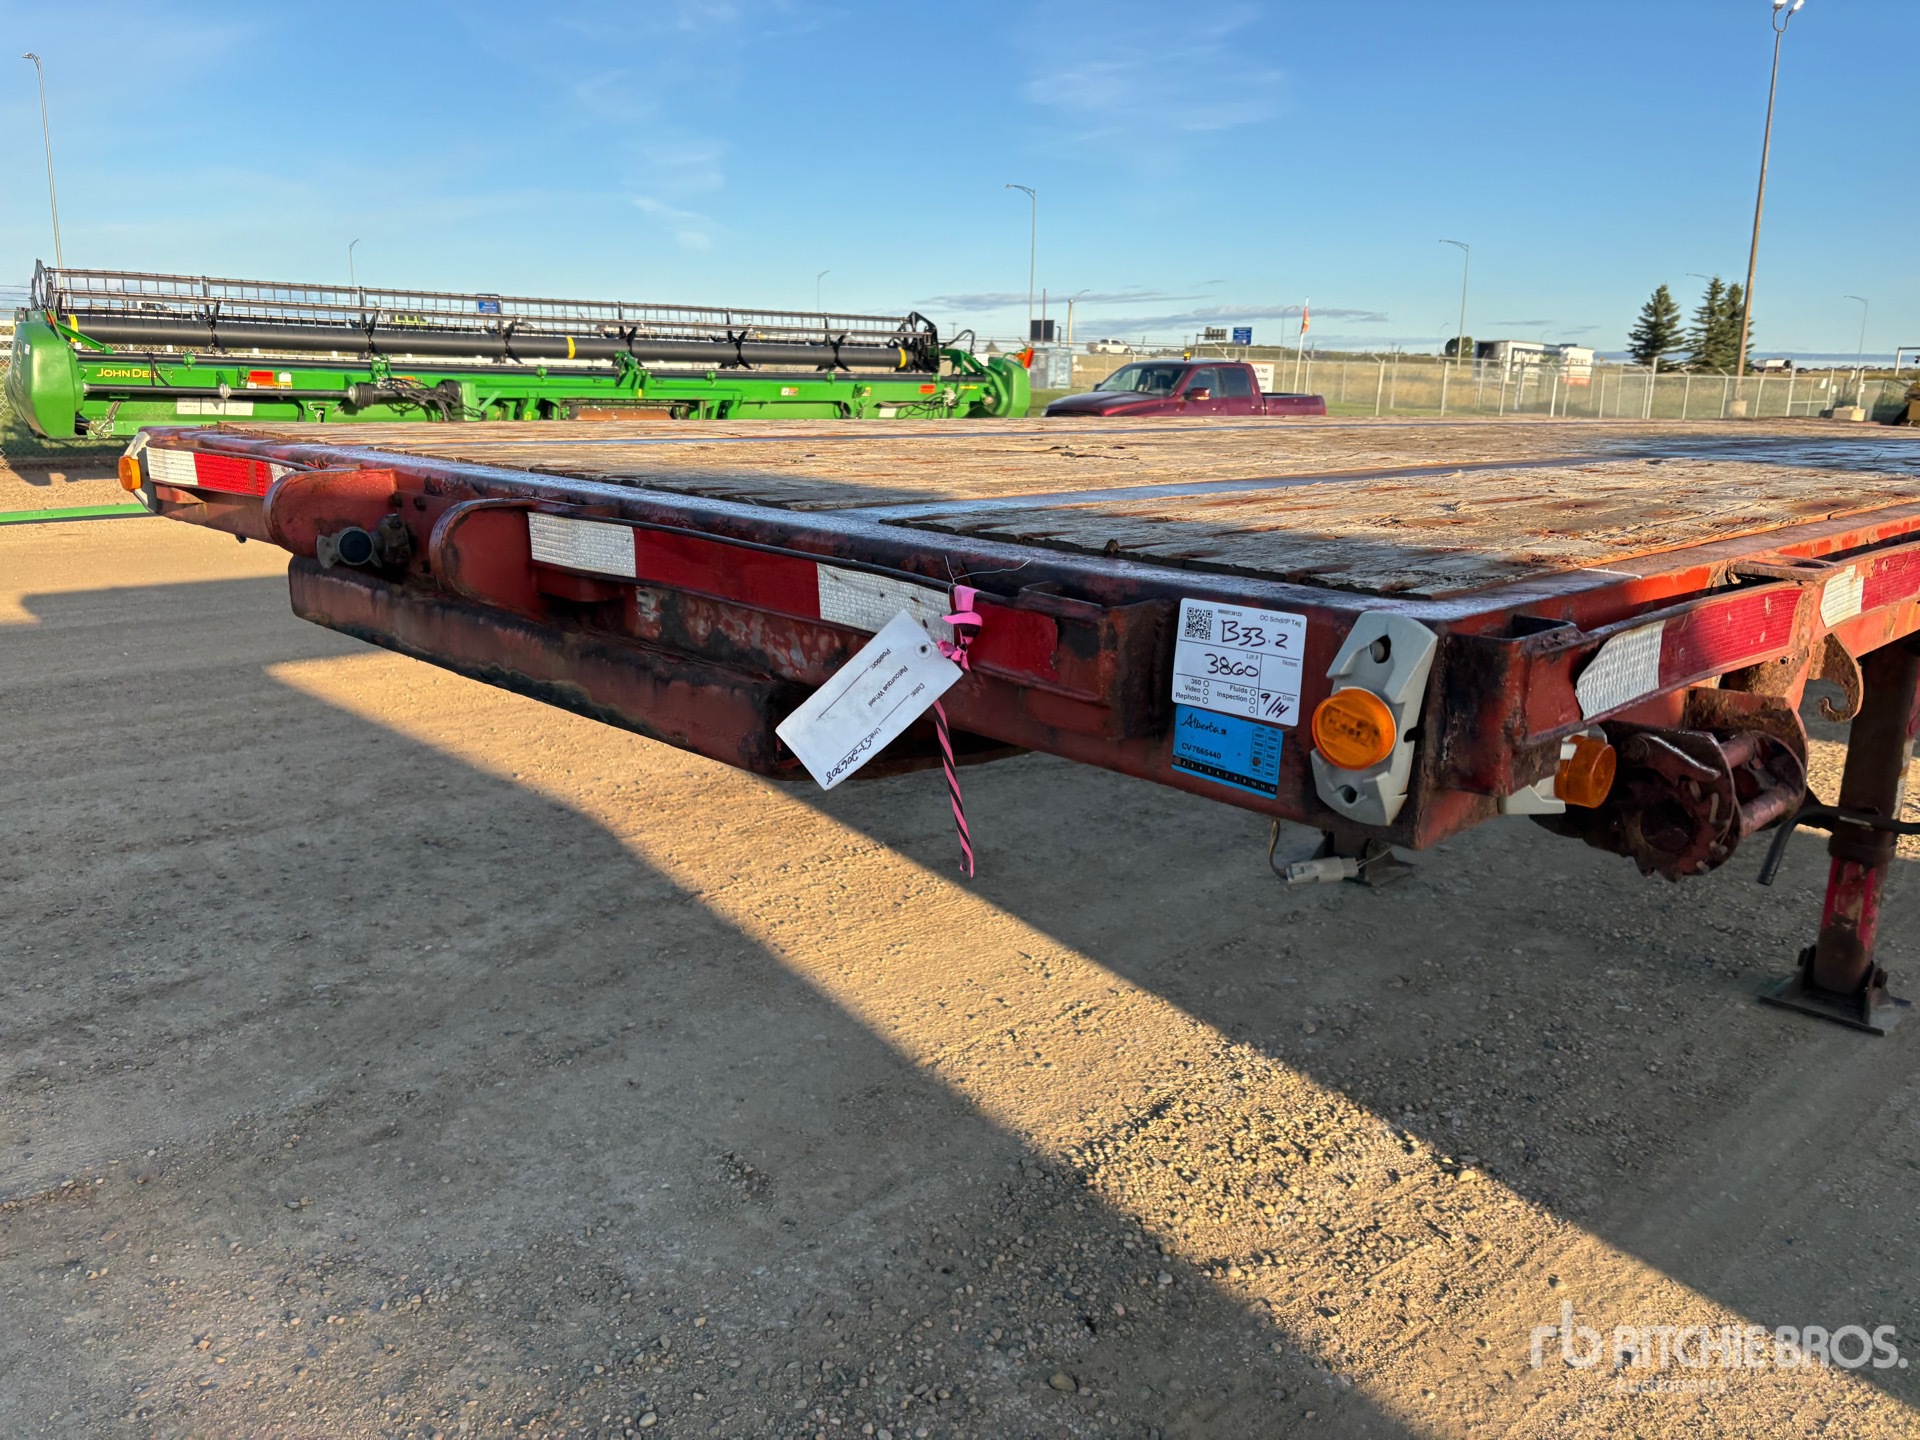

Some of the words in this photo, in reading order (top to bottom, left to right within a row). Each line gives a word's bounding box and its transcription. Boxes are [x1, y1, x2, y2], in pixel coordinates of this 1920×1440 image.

[97, 368, 130, 378] JOHN
[870, 648, 891, 671] Position:
[1204, 653, 1259, 678] 3860
[911, 682, 926, 698] Date:
[1184, 684, 1200, 693] Video
[1216, 691, 1248, 702] Inspection
[1230, 685, 1248, 694] Fluids
[868, 690, 886, 708] Wheel
[1176, 692, 1200, 702] Rephoto
[1260, 693, 1290, 718] 9/14
[1180, 713, 1220, 734] Alberta
